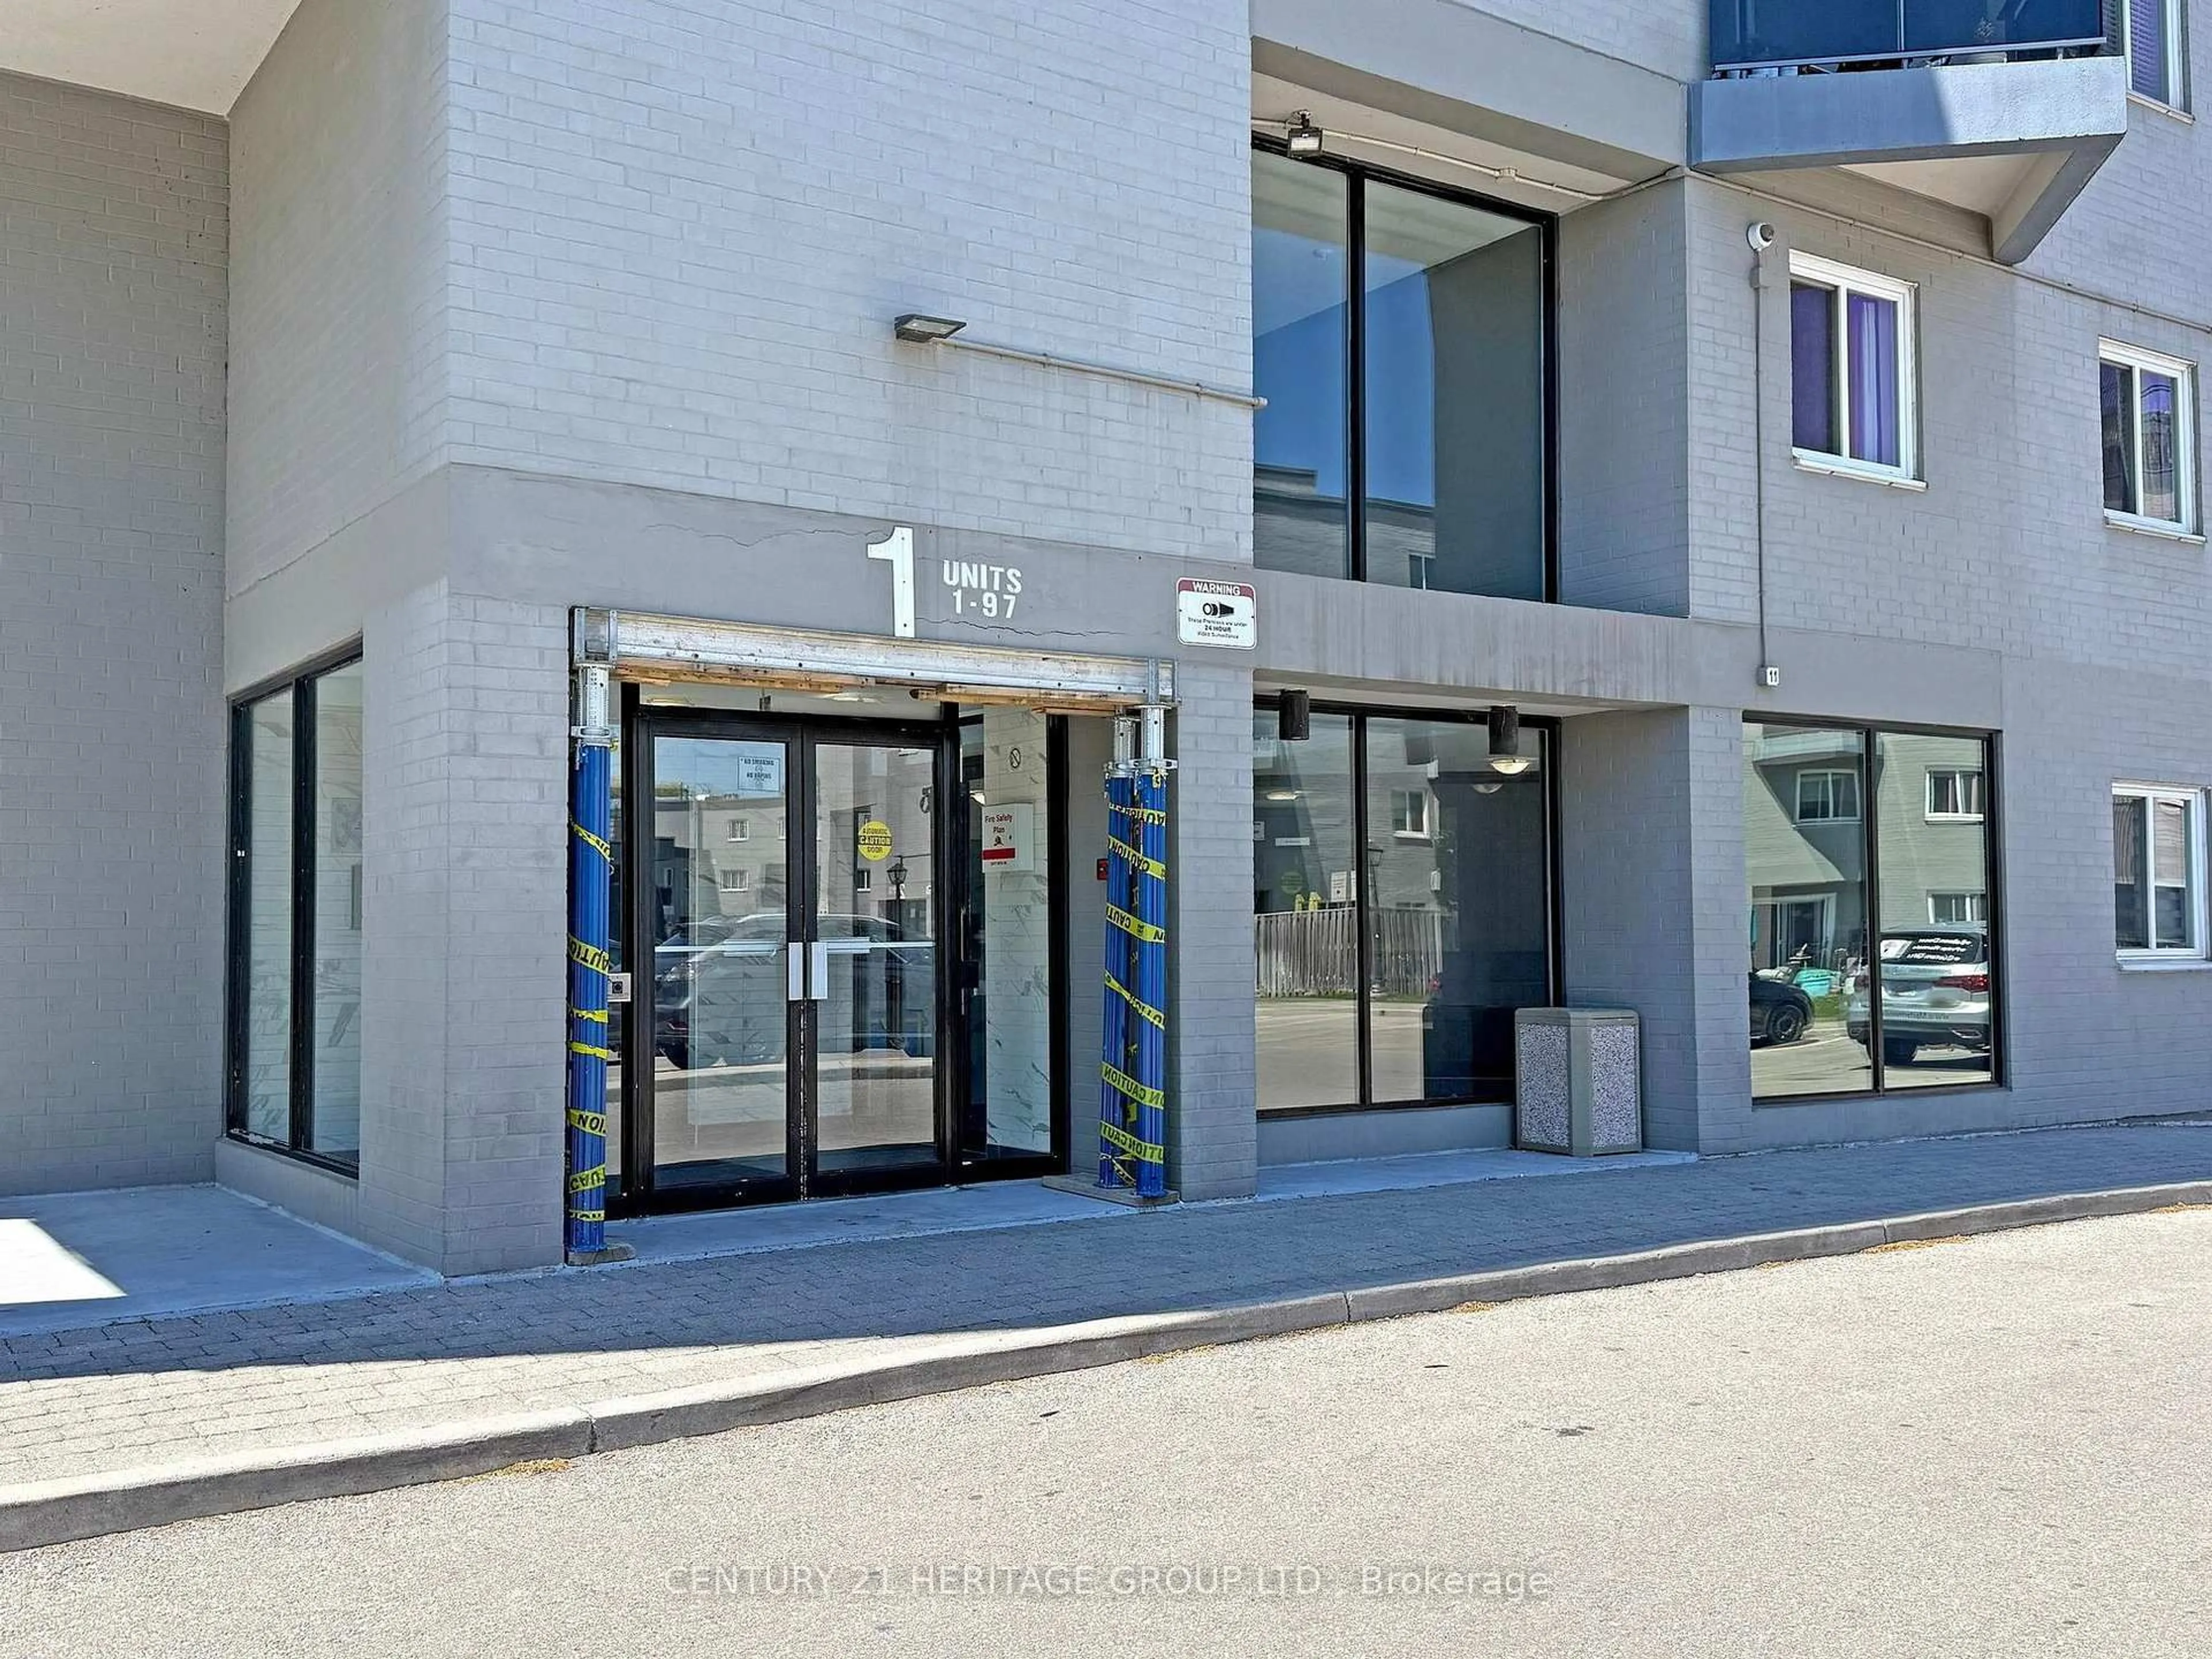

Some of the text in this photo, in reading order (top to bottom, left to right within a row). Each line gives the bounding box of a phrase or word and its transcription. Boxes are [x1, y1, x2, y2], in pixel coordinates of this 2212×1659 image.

[867, 526, 915, 638] 1
[943, 559, 1022, 594] UNITS
[1192, 581, 1241, 596] WARNING
[996, 813, 1013, 823] Safety
[860, 836, 891, 845] CAUTION
